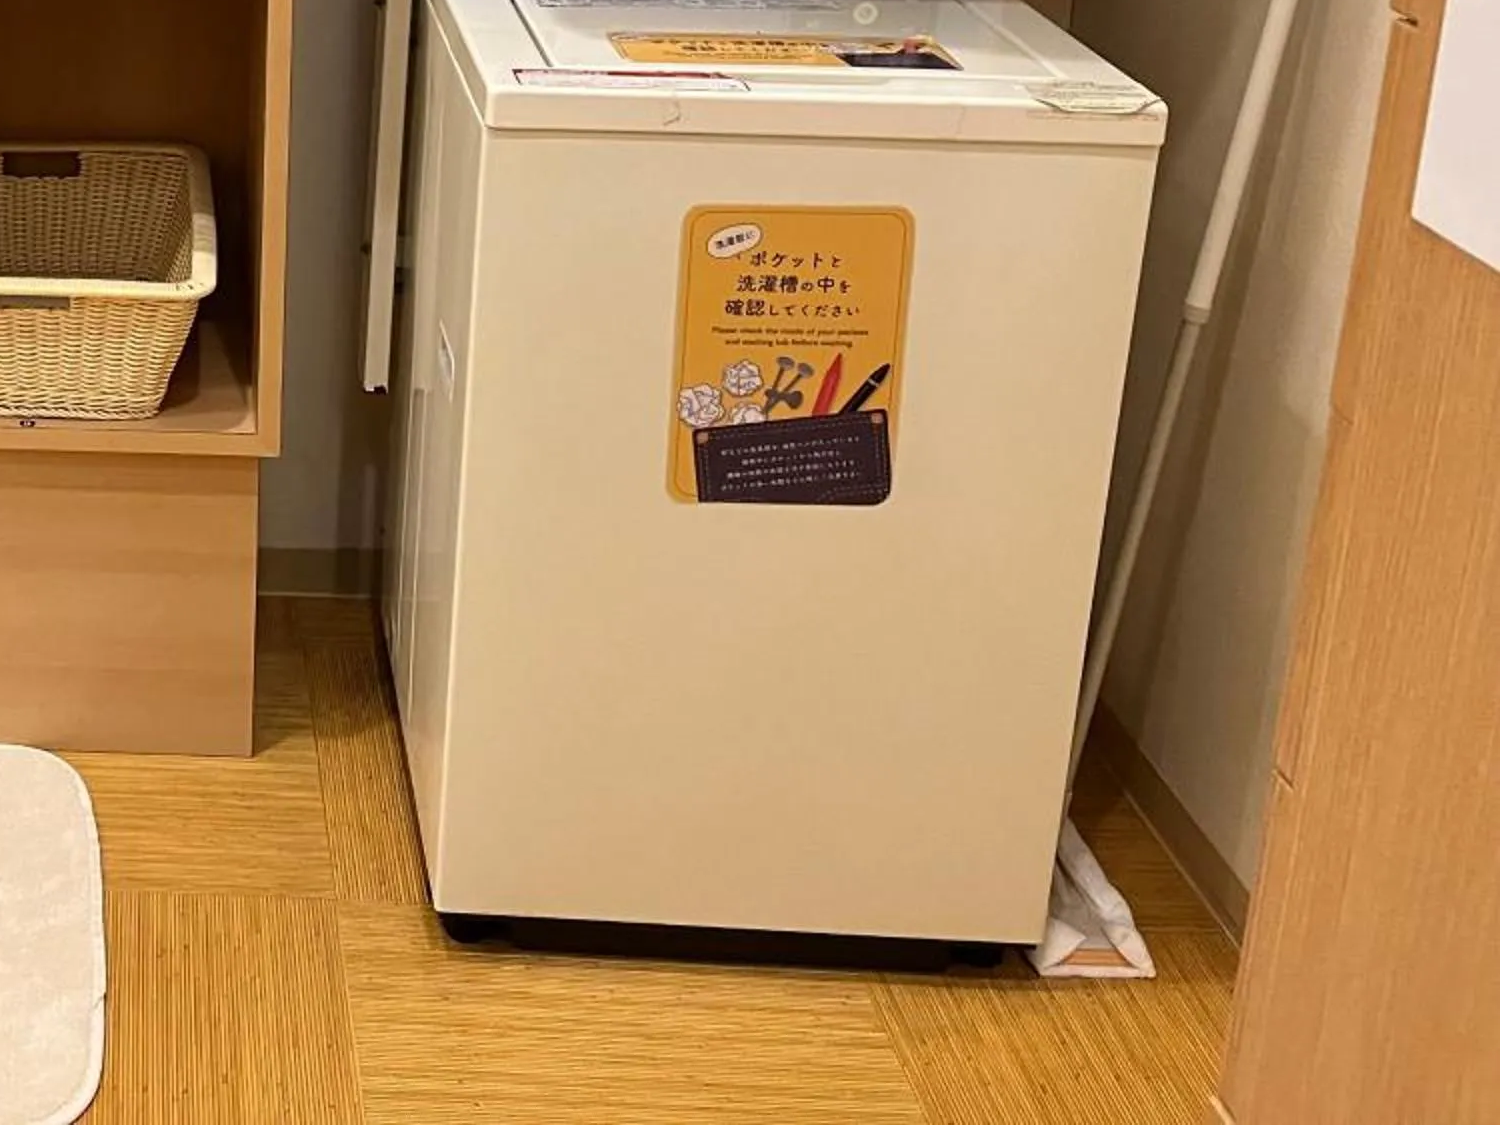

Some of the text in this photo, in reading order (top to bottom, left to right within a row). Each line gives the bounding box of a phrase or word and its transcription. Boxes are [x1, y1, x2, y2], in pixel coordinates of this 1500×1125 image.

[750, 251, 841, 269] ポケットと
[736, 274, 851, 294] 洗濯槽の中を
[724, 299, 860, 317] 確認してください
